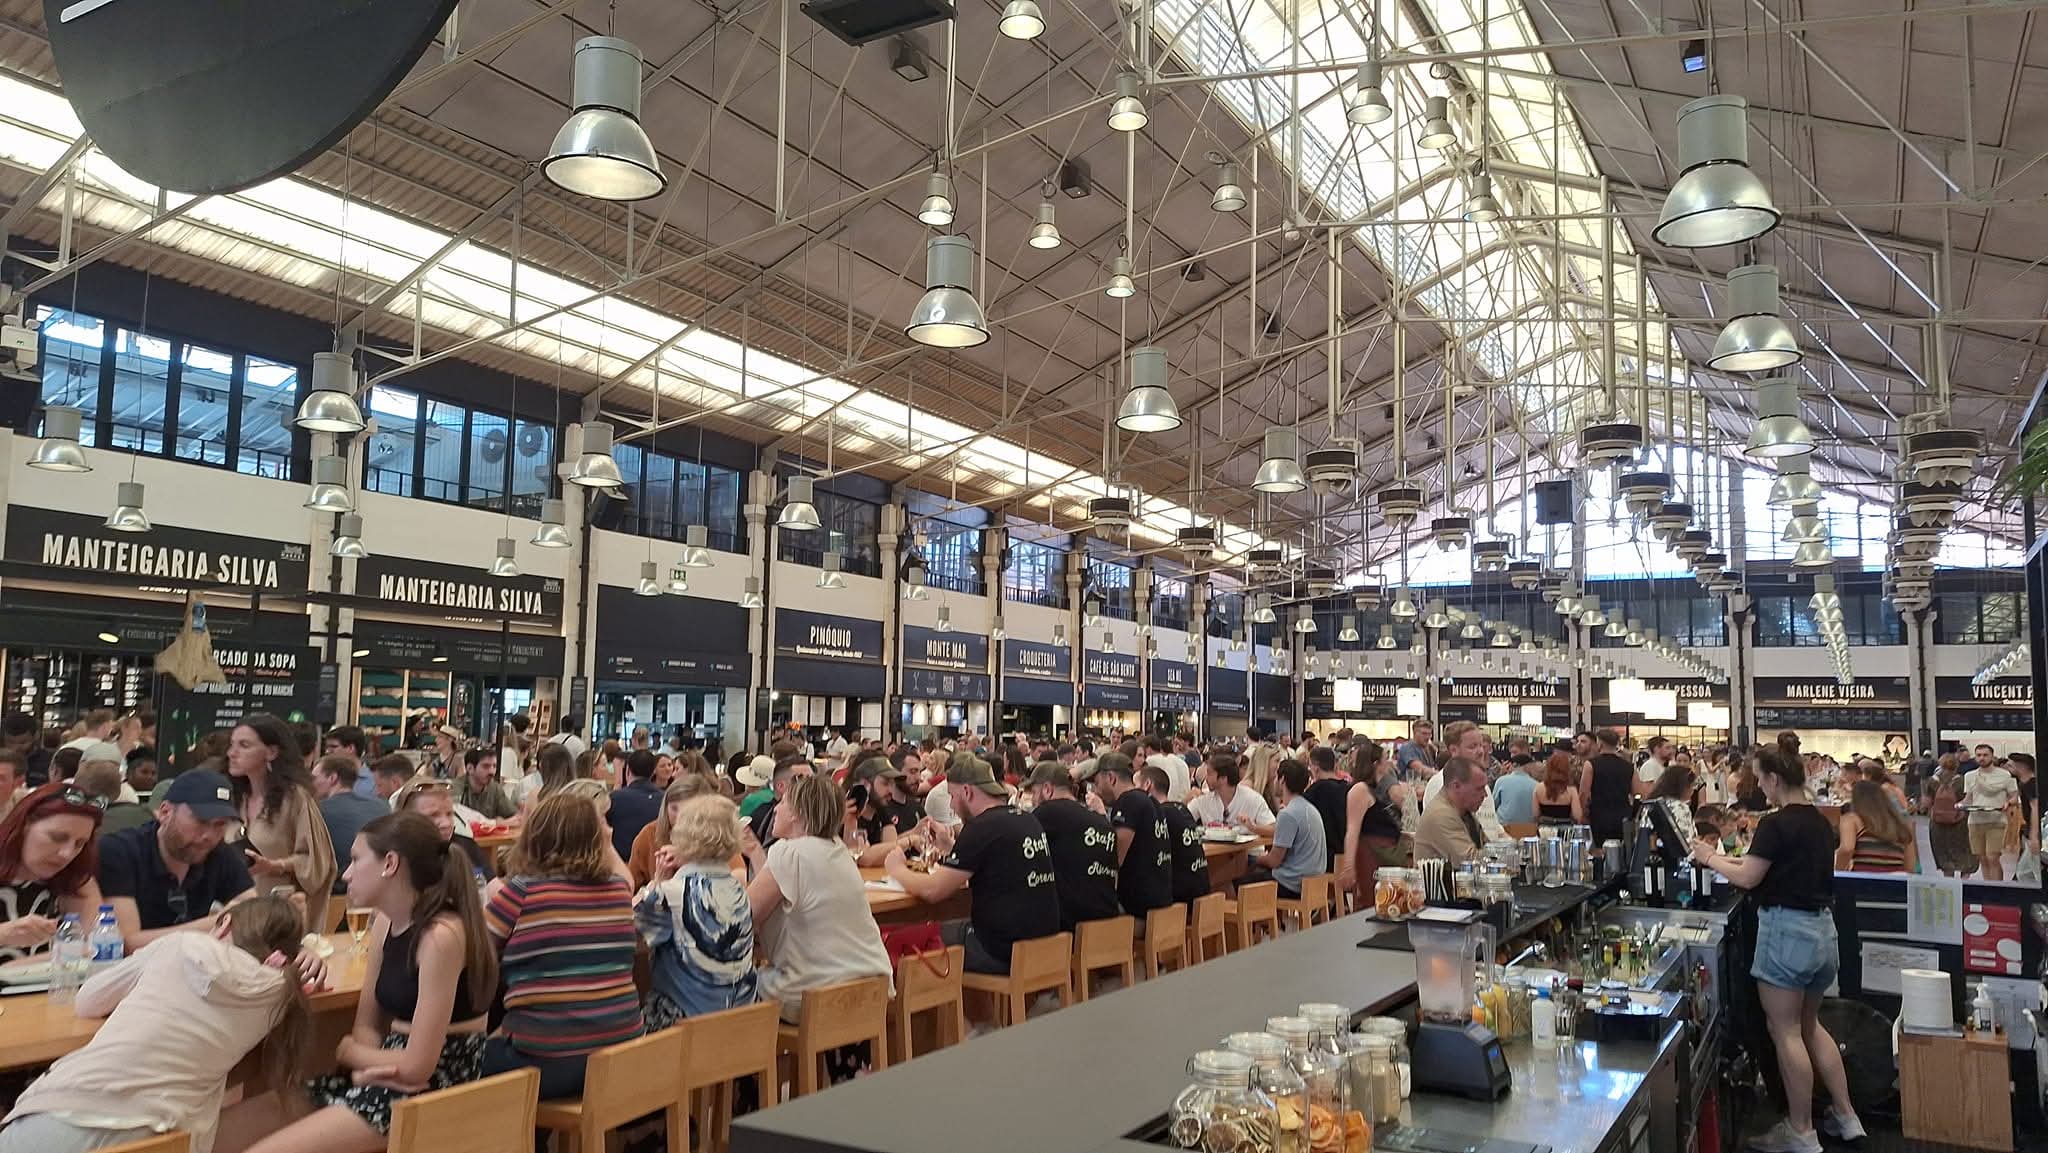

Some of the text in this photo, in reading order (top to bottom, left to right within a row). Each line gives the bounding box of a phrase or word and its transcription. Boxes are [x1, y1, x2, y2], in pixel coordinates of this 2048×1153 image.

[43, 534, 279, 588] MANTEIGARIA SILVA
[380, 574, 542, 615] MANTEIGARIA SILVA
[810, 624, 851, 648] PINÓQUIO
[213, 649, 248, 666] RCADO
[269, 653, 296, 669] SOPA
[926, 639, 967, 660] MONTE MAR
[1019, 649, 1056, 668] CROQUETERIA
[1363, 684, 1399, 697] LICIDAD
[1452, 684, 1556, 697] MIGUEL CASTRO E SILVA
[1674, 684, 1712, 698] PESSOA
[1786, 684, 1875, 698] MARLENE VIEIRA
[1972, 685, 2023, 699] VINCENT
[1022, 831, 1051, 859] Staff
[1084, 826, 1115, 852] Staff
